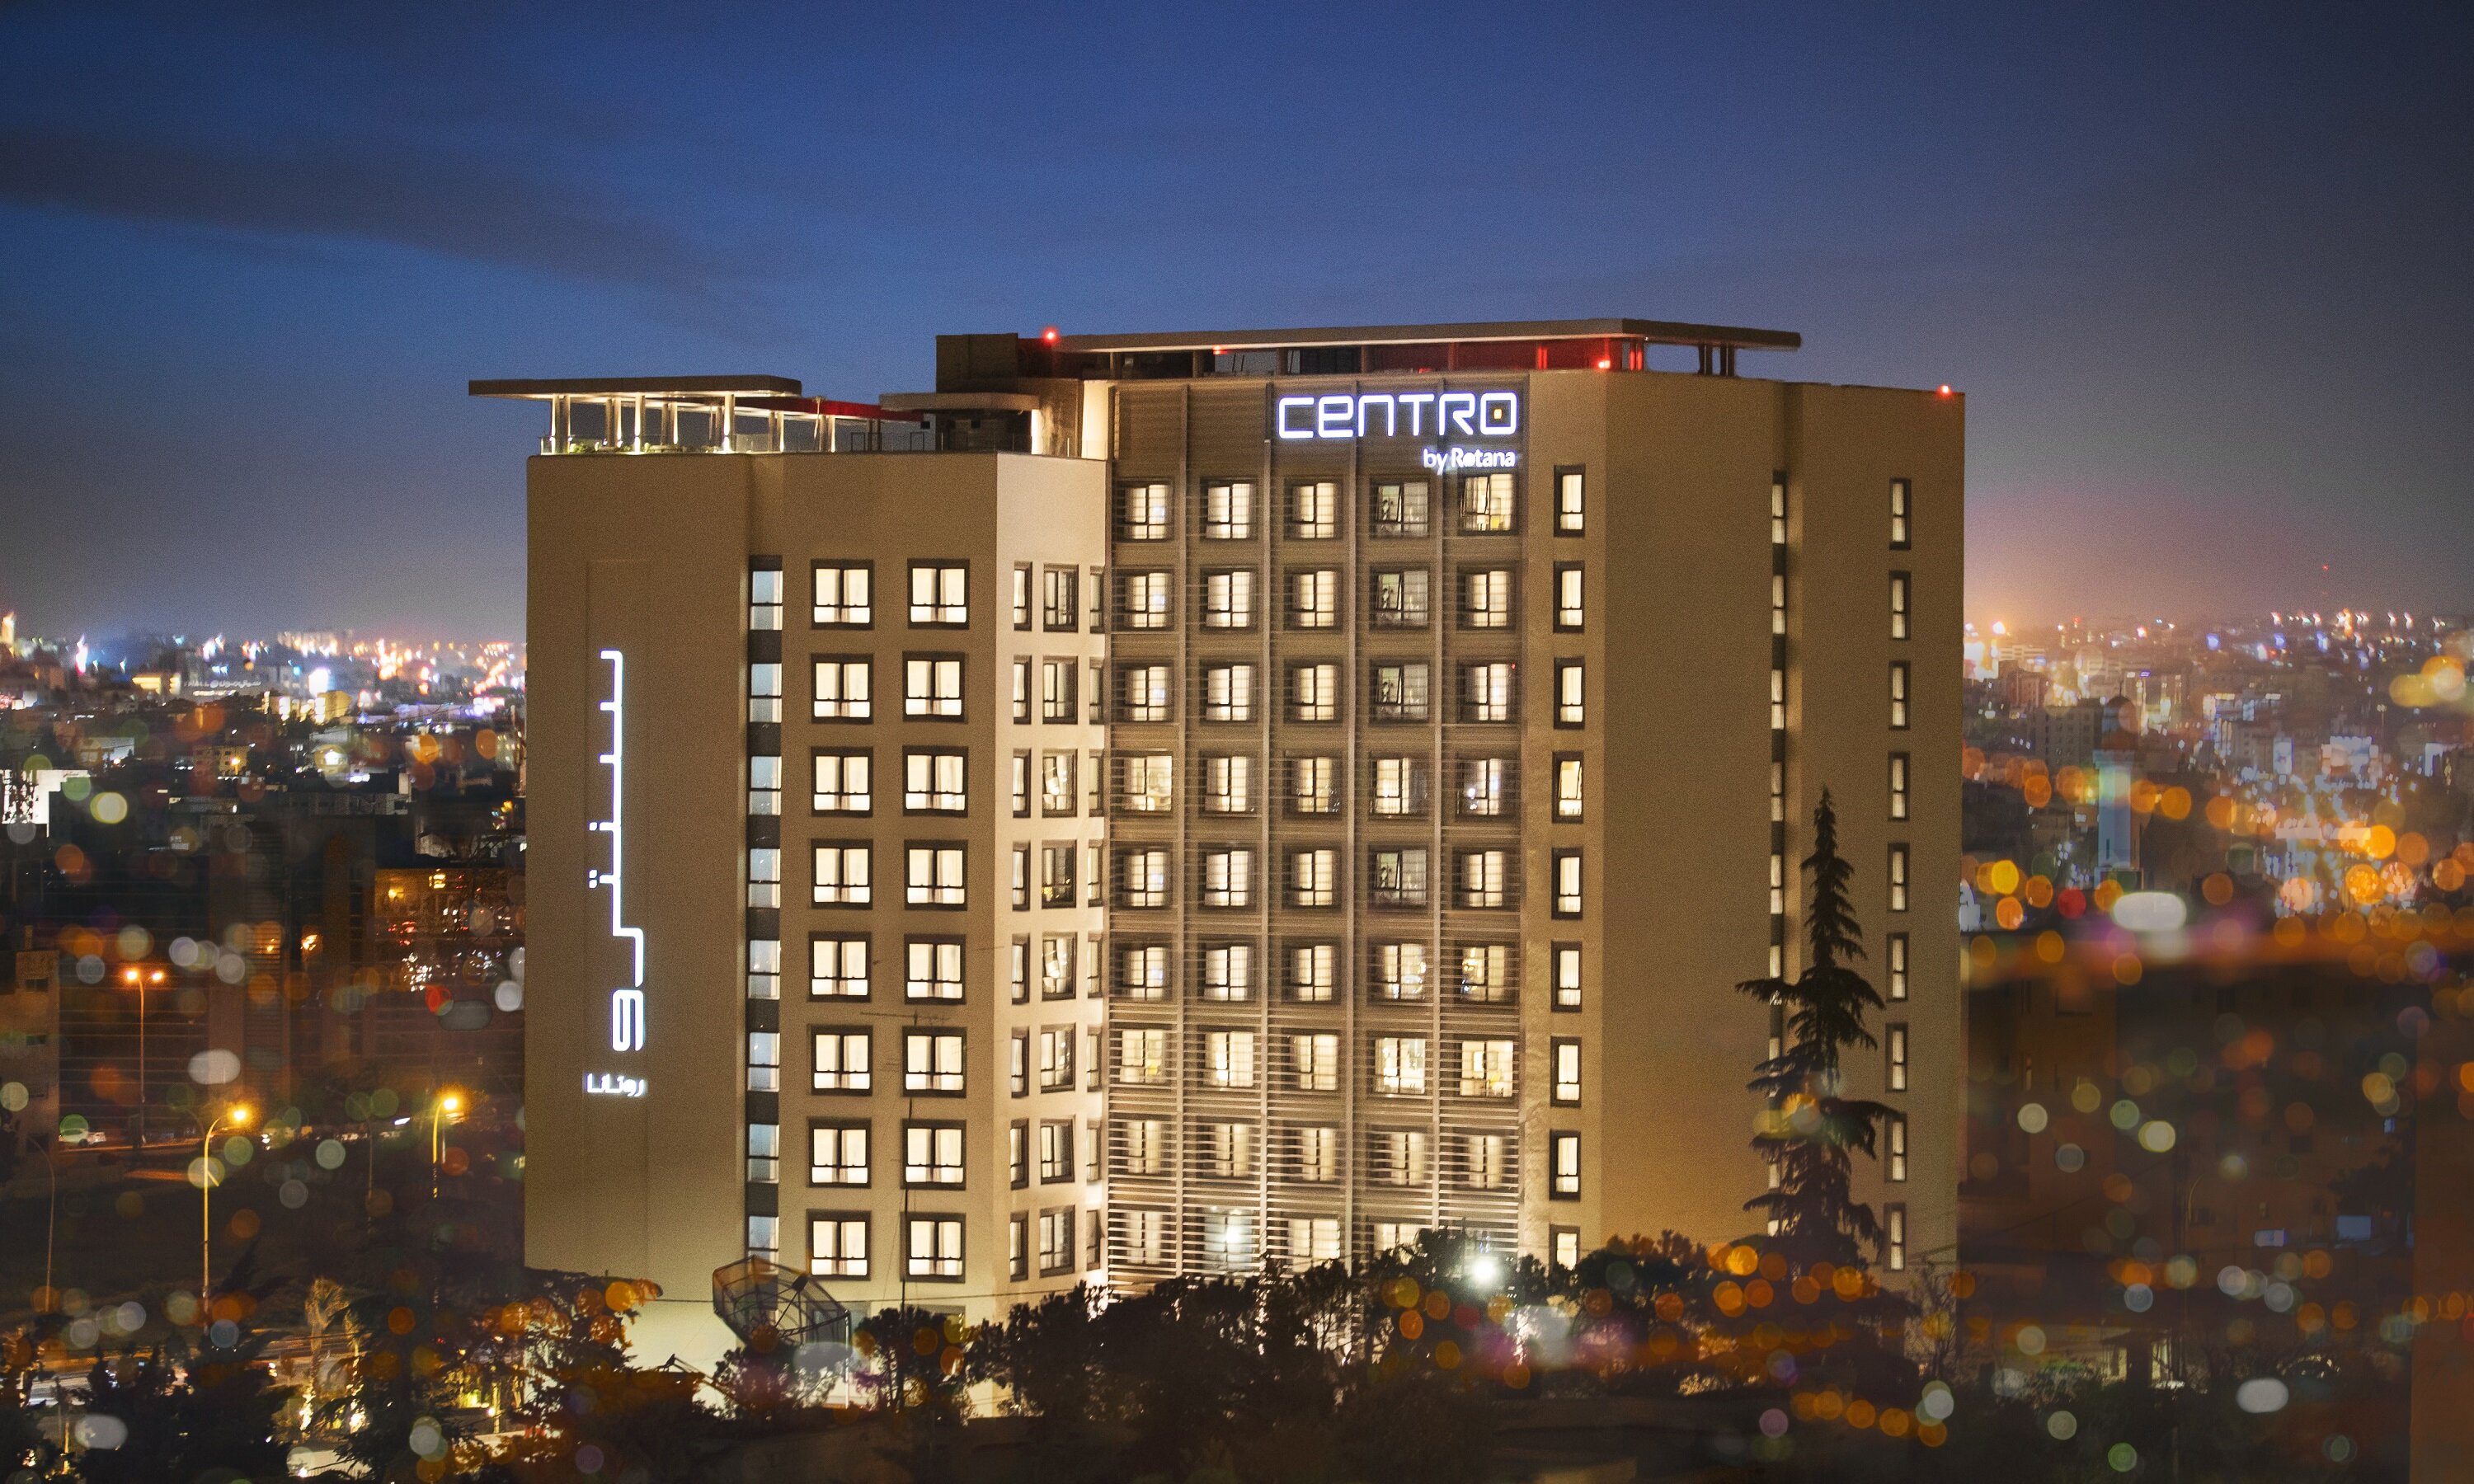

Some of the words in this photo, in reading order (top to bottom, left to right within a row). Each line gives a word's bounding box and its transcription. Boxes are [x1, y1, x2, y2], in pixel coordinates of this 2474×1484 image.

[1423, 448, 1448, 476] by
[1451, 447, 1517, 468] Rotana
[586, 1072, 646, 1097] روتانا
